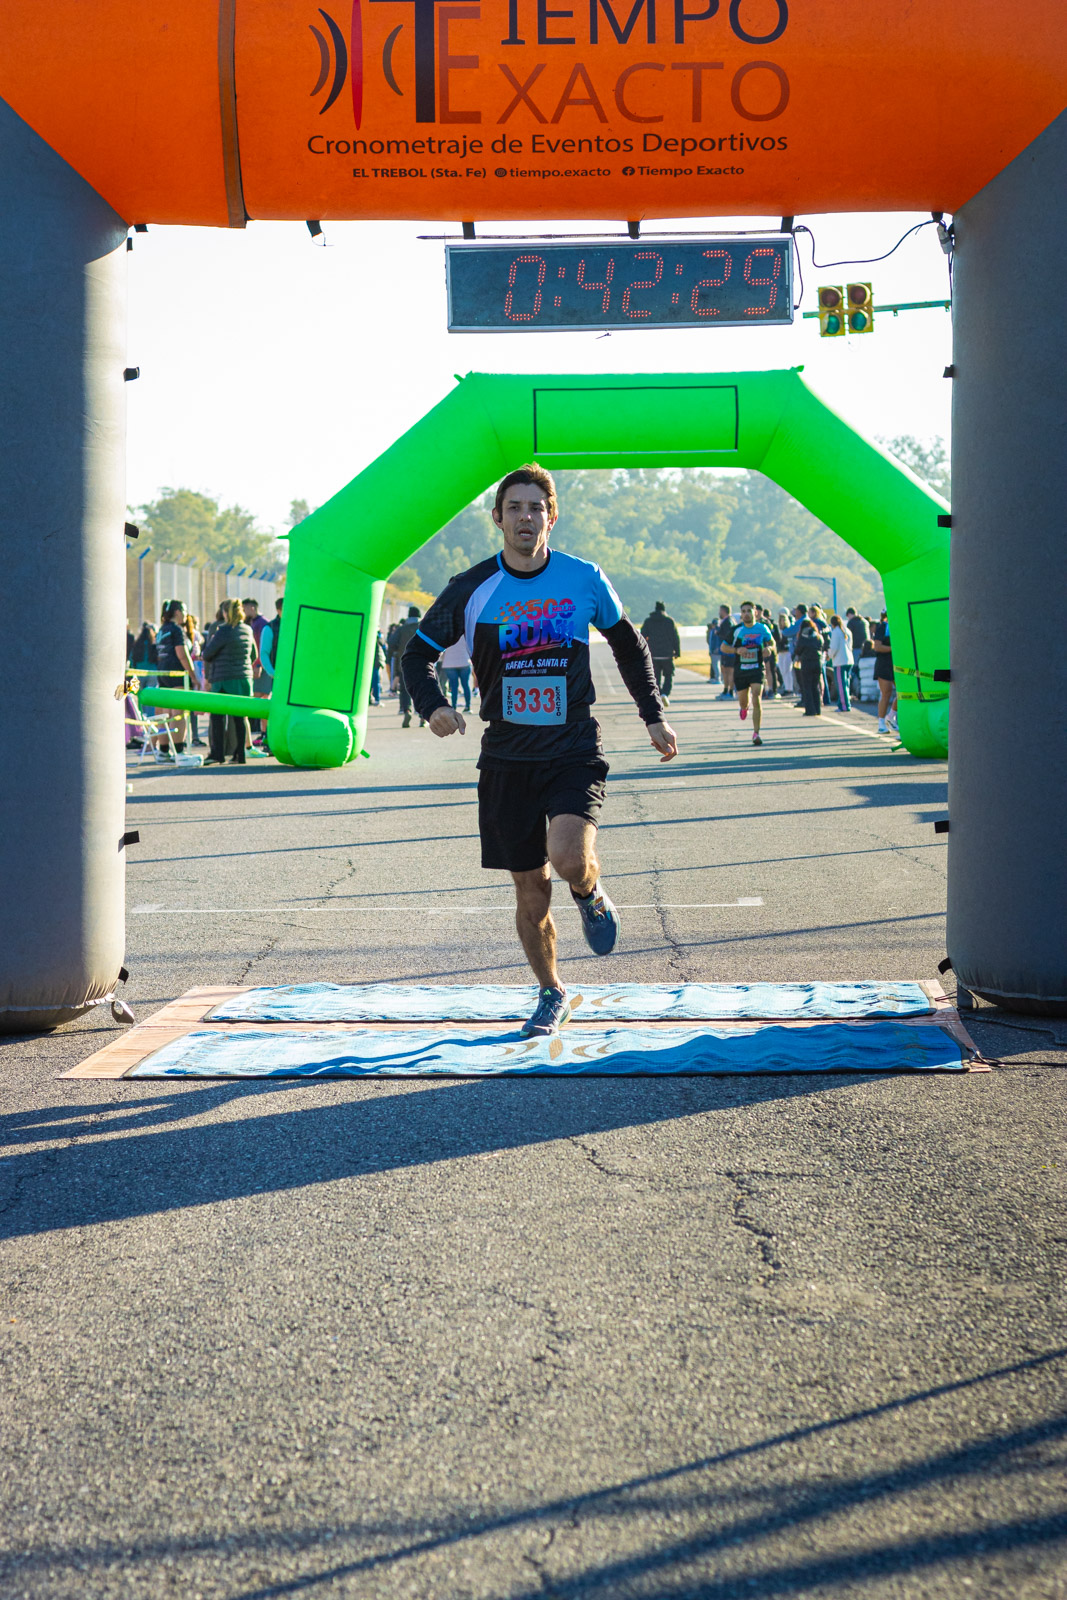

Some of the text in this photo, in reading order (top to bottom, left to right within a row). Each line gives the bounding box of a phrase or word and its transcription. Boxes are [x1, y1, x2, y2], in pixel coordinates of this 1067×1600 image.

[307, 132, 789, 159] Cronometraje de Eventos Deportivos
[353, 165, 745, 179] EL TREBOL (Sta. Fe) tiempo.exacto Tiempo Exacto
[504, 248, 781, 321] 0:42:29
[536, 658, 559, 667] SANTA
[559, 658, 569, 667] FE
[513, 687, 556, 713] 333
